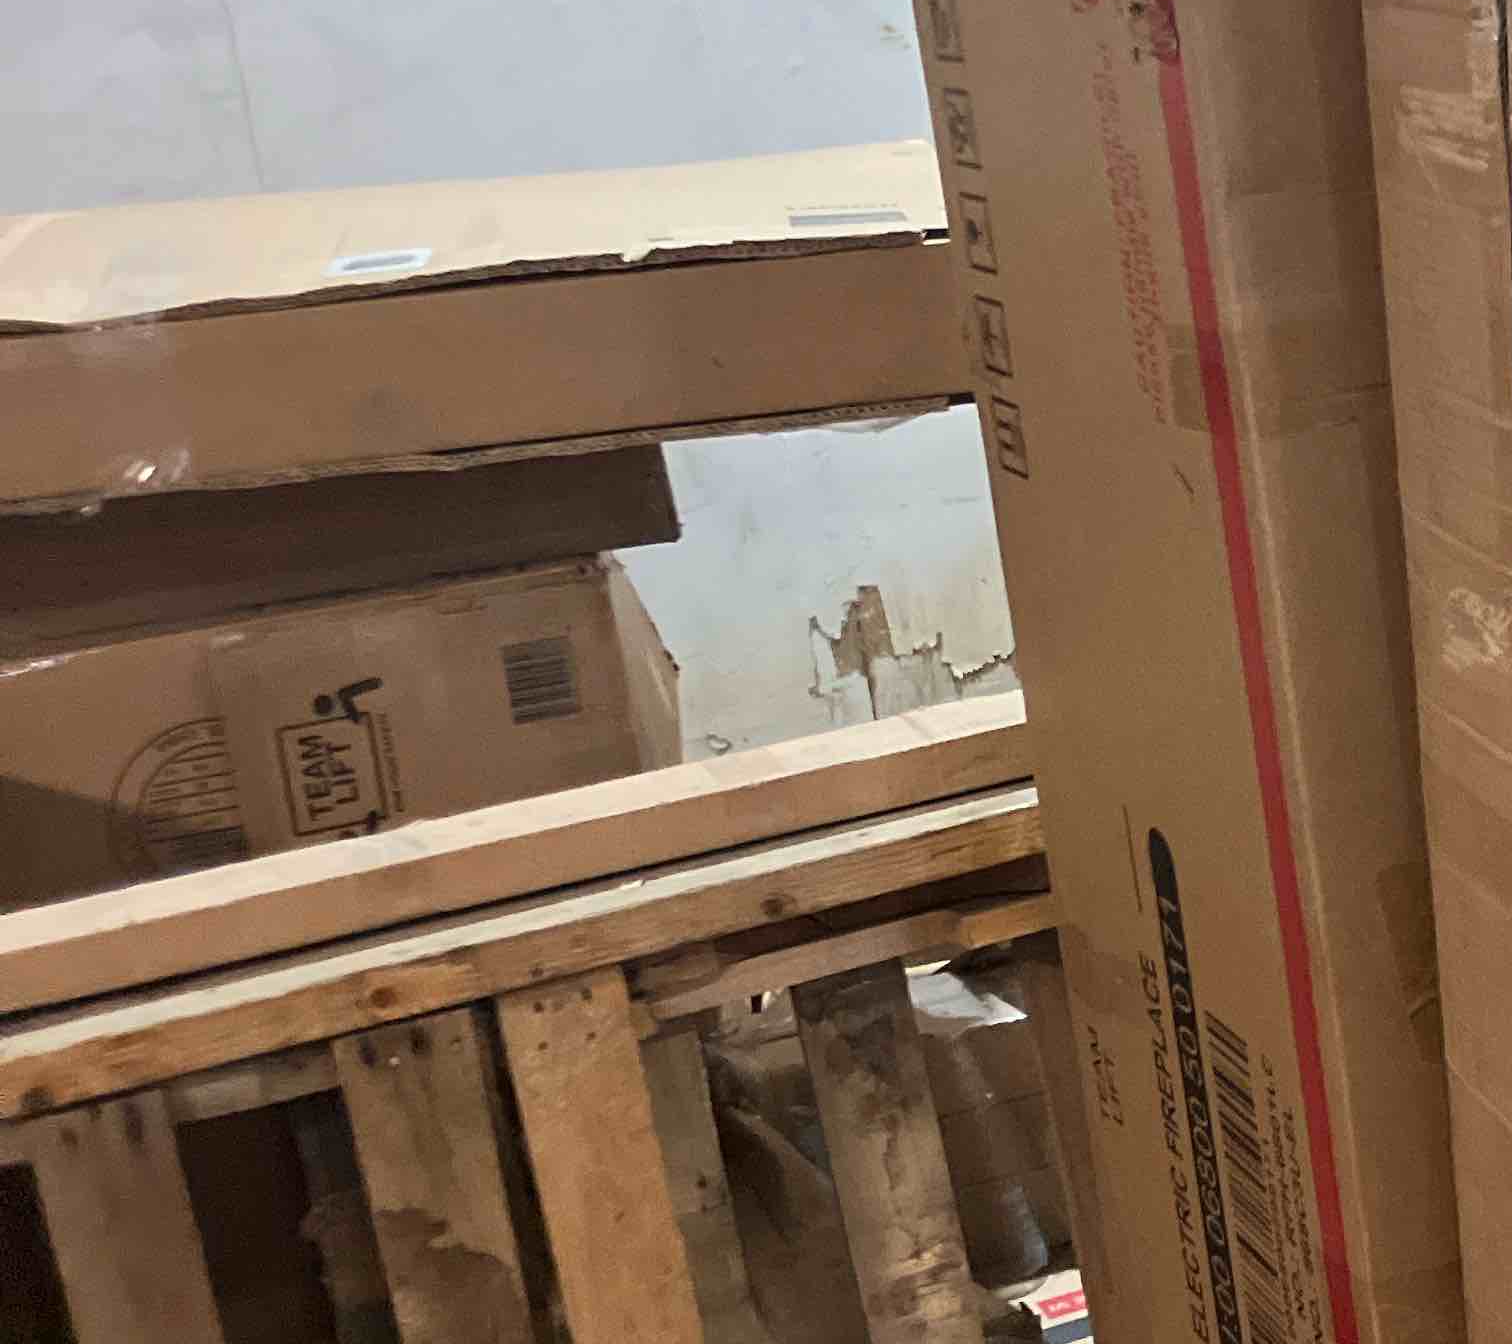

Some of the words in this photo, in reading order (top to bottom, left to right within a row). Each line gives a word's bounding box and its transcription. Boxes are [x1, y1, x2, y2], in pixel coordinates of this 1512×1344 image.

[297, 735, 336, 822] TEAM
[325, 743, 360, 805] LIFT
[1136, 950, 1183, 1162] FIREPLACE
